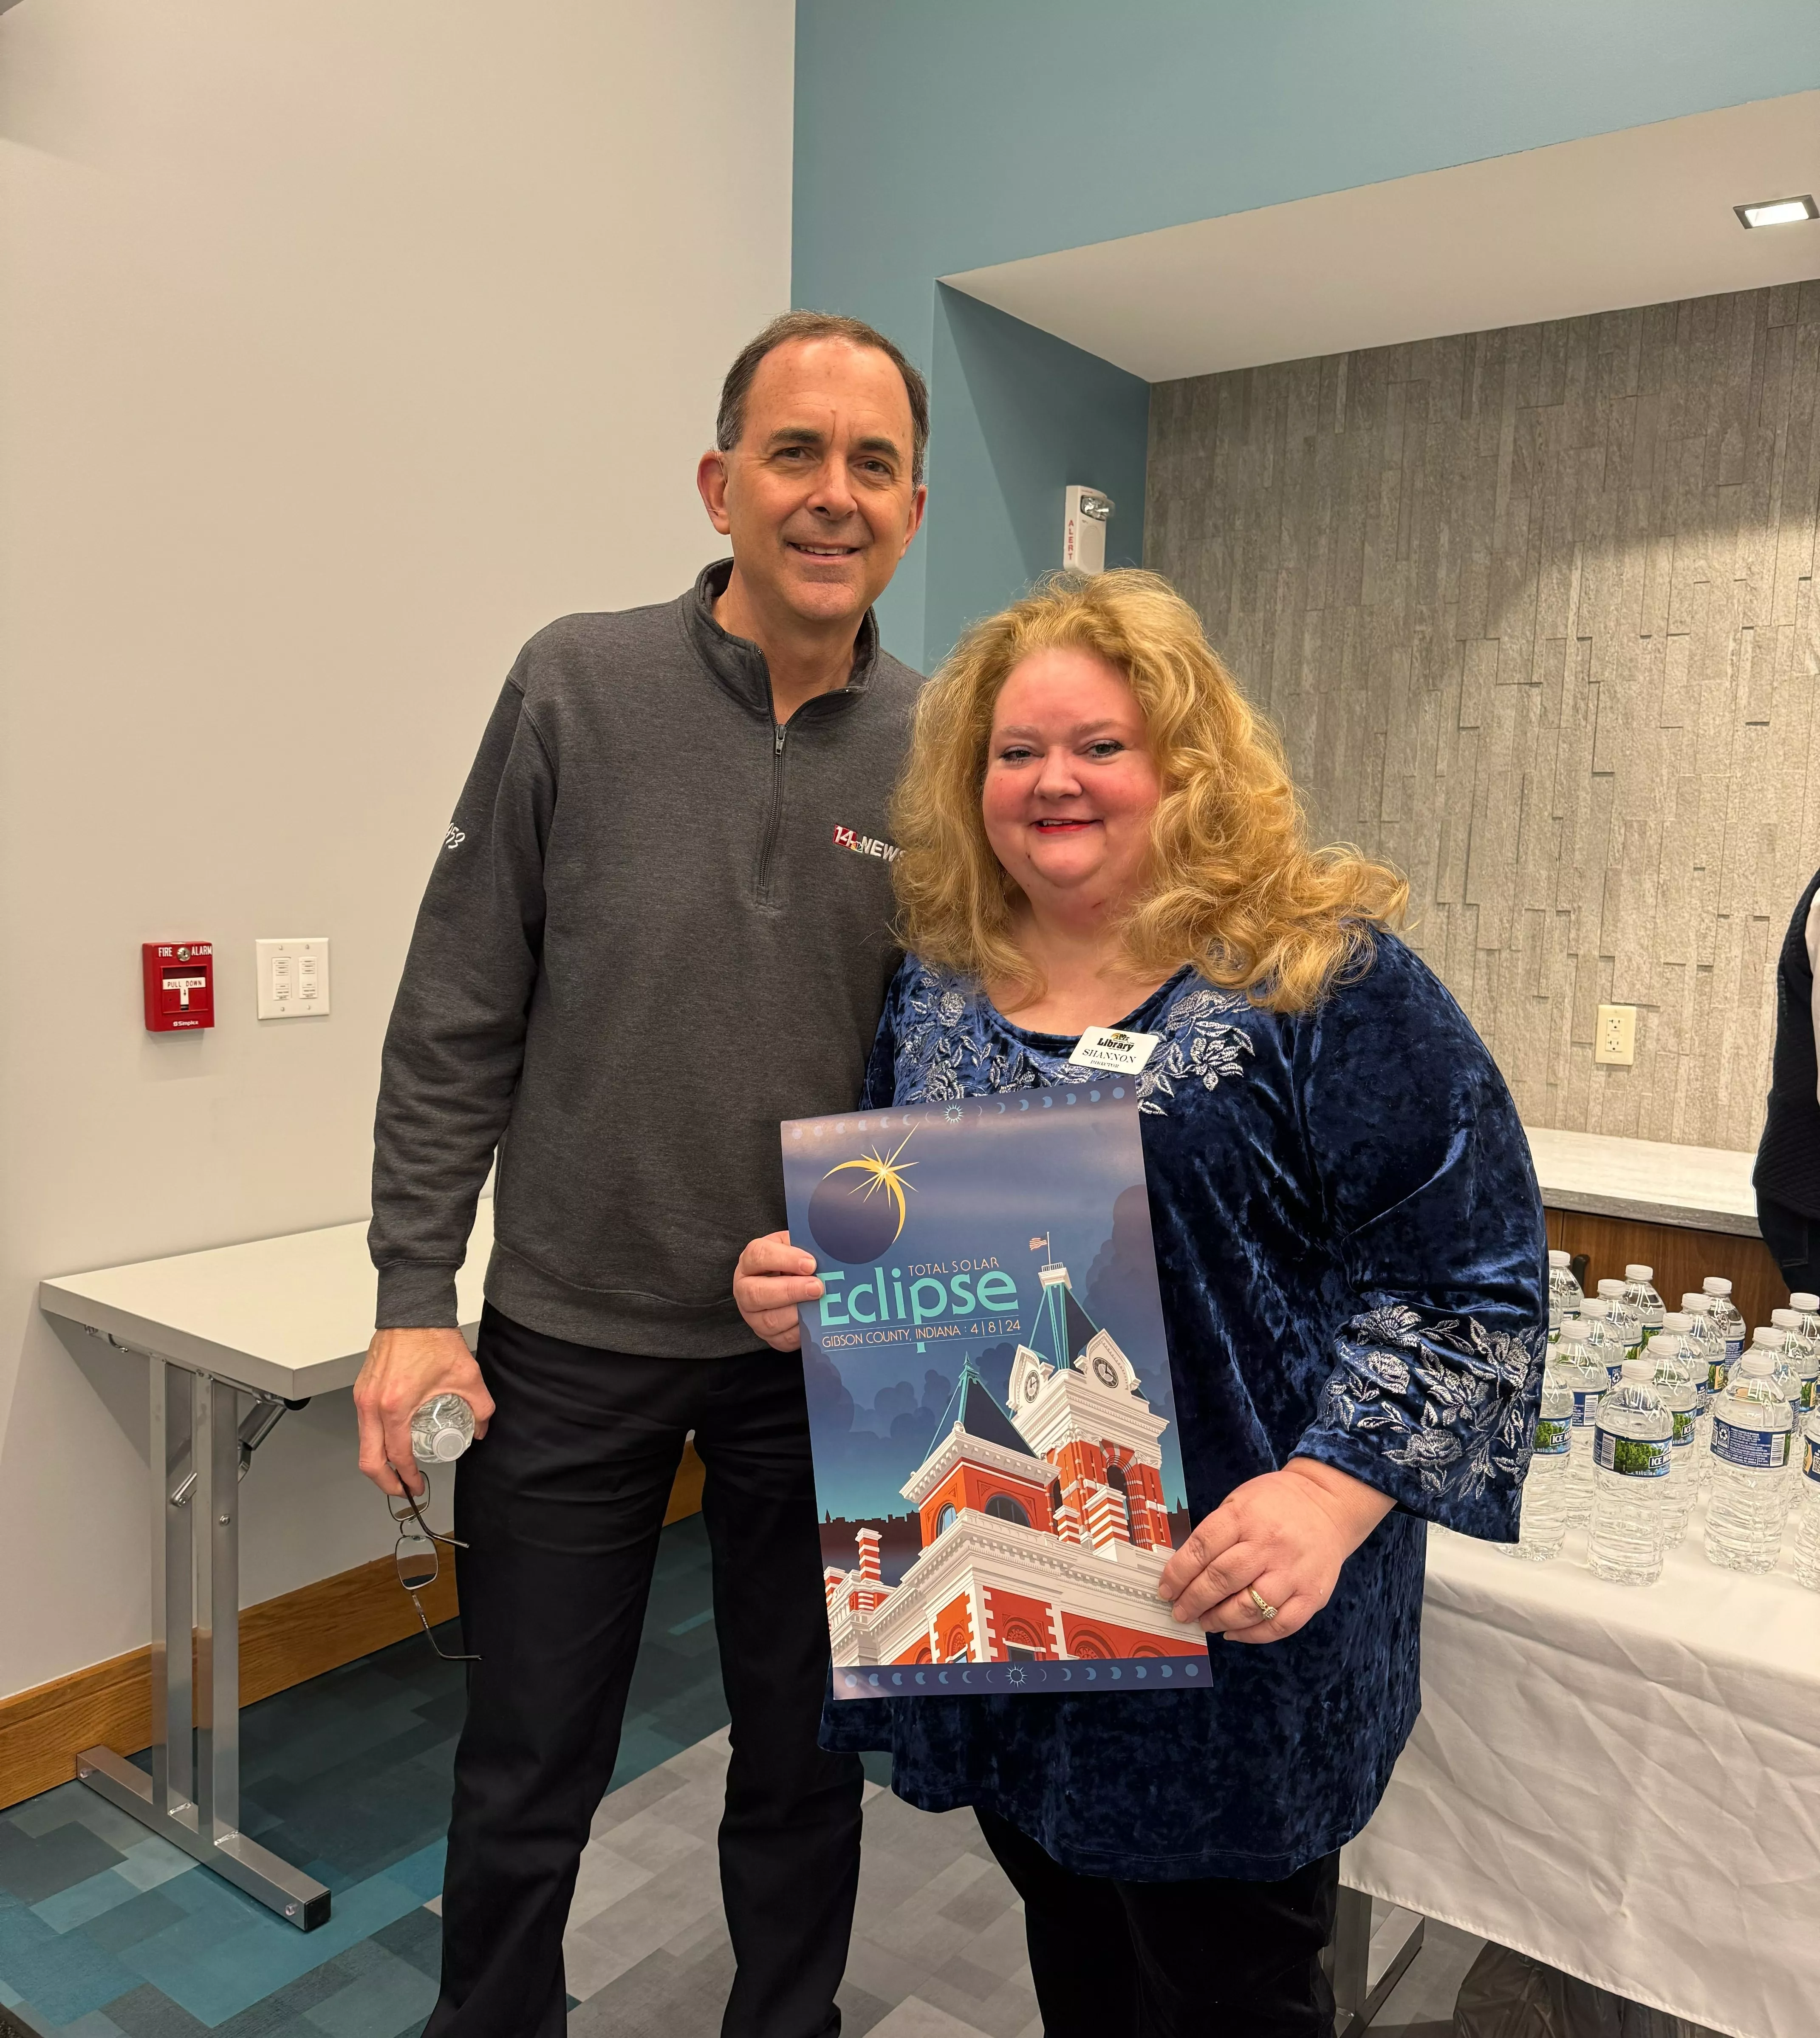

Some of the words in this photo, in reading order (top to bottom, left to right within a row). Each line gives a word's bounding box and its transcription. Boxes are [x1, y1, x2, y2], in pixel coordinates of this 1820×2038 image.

[835, 826, 854, 847] 14
[158, 947, 173, 957] FIRE
[192, 945, 212, 956] ALARM
[1097, 1038, 1135, 1052] Library
[1082, 1049, 1136, 1063] SHANNON
[1090, 1060, 1119, 1068] DIRECTOR
[908, 1262, 949, 1276] TOTAL
[952, 1257, 999, 1272] SOLAR
[816, 1266, 1019, 1353] Eclipse
[822, 1333, 863, 1347] GIBSON
[866, 1329, 912, 1343] COUNTY,
[916, 1325, 961, 1339] INDIANA
[1552, 1435, 1563, 1444] ICE
[1651, 1457, 1662, 1466] ICE
